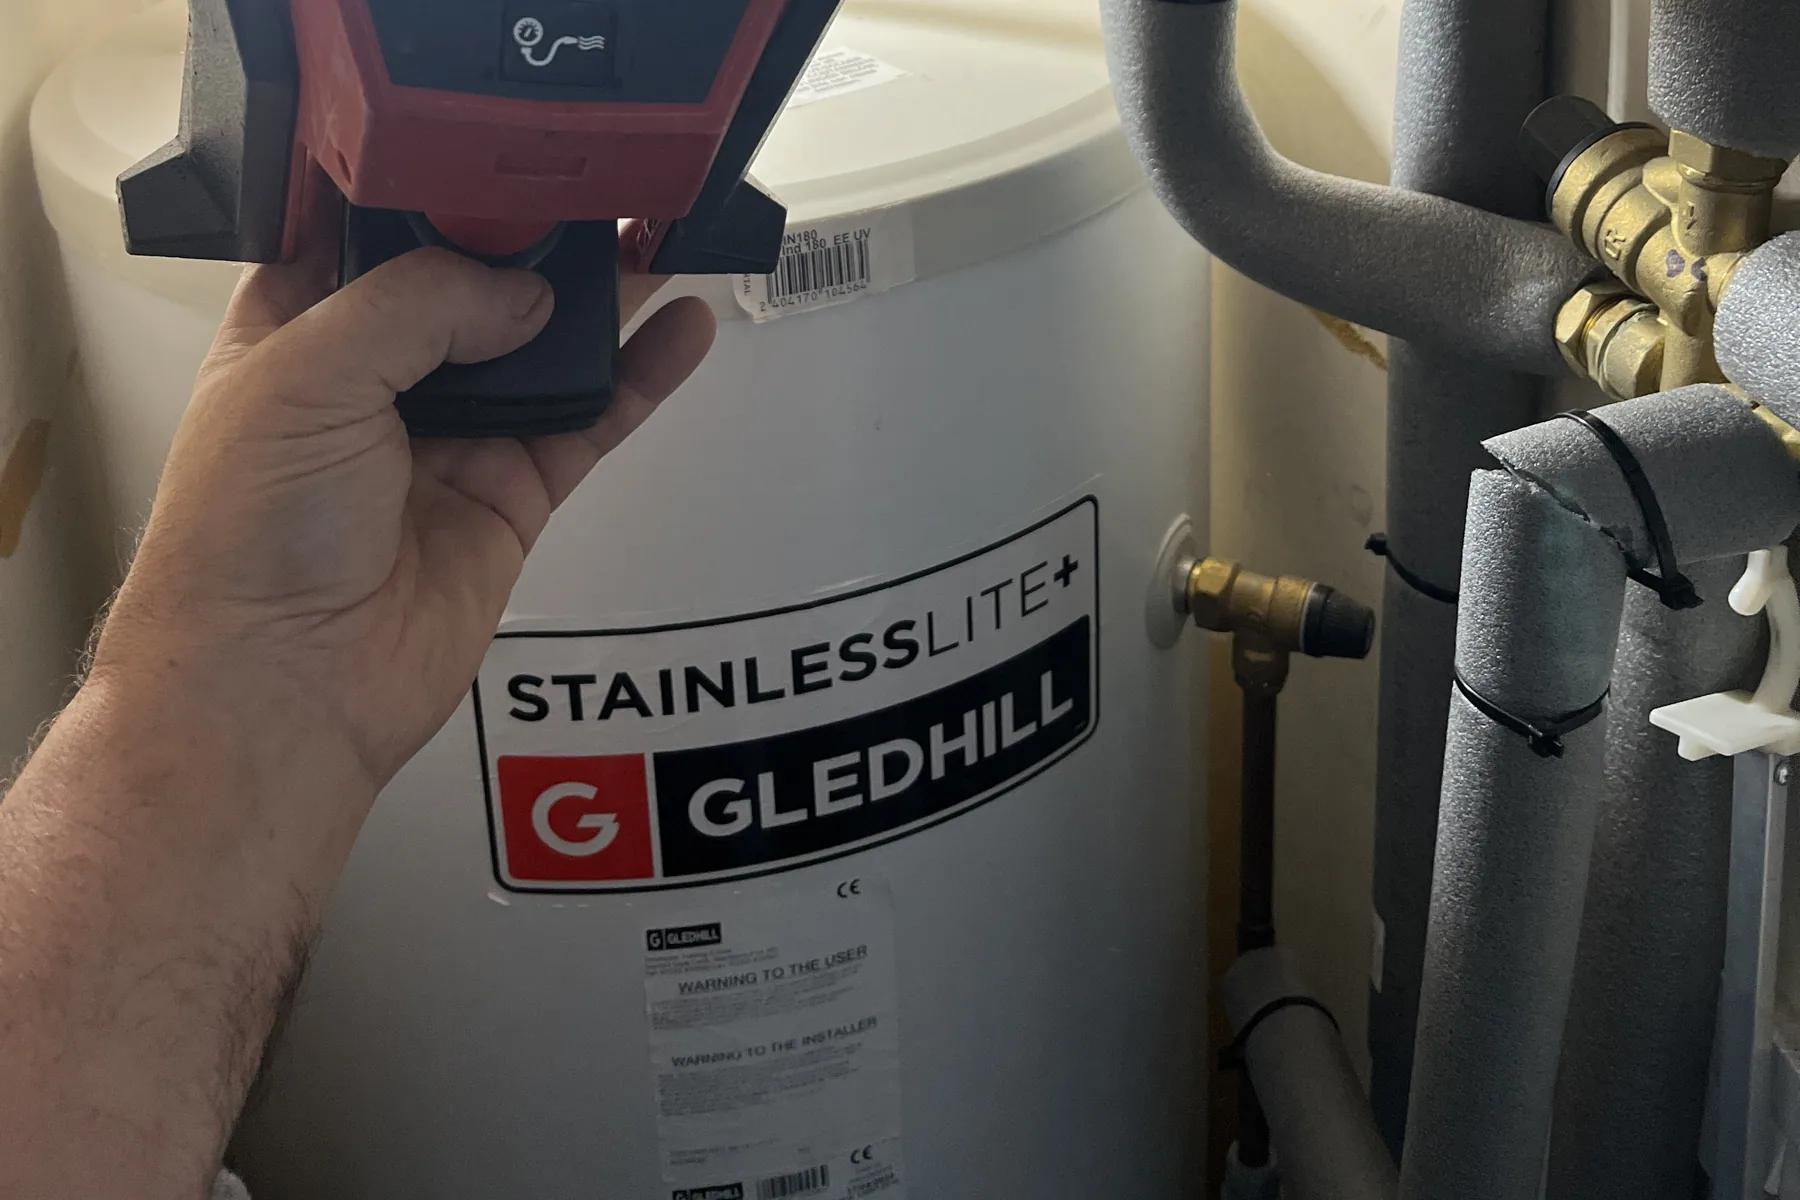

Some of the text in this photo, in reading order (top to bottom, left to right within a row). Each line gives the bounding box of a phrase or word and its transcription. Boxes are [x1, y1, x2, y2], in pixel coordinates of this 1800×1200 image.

[783, 229, 818, 245] IN180
[833, 231, 850, 246] EE
[854, 226, 872, 241] UV
[531, 669, 1075, 857] G GLEDHILL
[667, 928, 719, 945] GLEDHILL
[678, 971, 757, 995] WARNING
[763, 966, 785, 982] TO
[789, 958, 820, 975] THE
[825, 944, 868, 969] USER
[671, 1015, 878, 1068] WARNING TO THE INSTALLER
